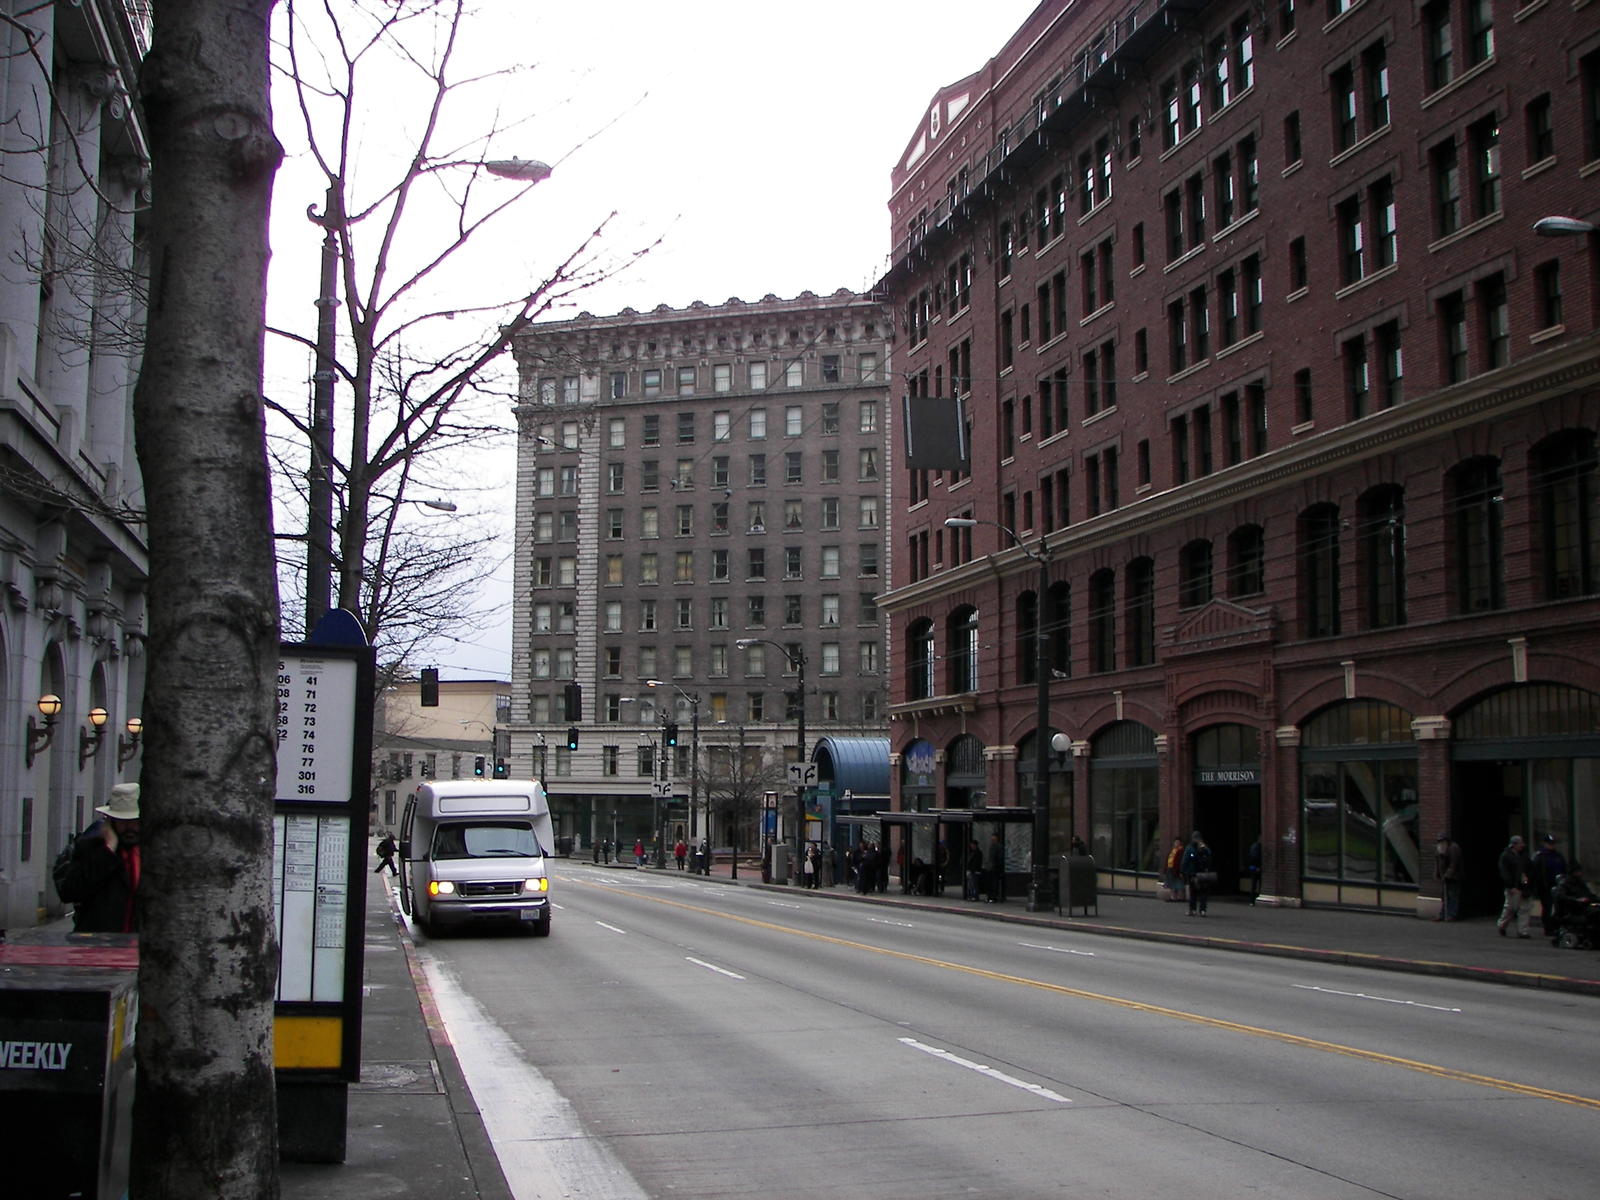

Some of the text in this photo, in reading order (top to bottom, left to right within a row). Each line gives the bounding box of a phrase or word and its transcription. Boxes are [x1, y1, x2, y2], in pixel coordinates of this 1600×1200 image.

[306, 676, 317, 686] 41
[306, 690, 316, 699] 71
[304, 703, 317, 713] 72
[303, 717, 316, 726] 73
[303, 731, 315, 740] 74
[302, 744, 315, 754] 76
[302, 758, 314, 767] 77
[298, 771, 316, 781] 301
[1217, 771, 1255, 781] MORRISON
[297, 785, 315, 794] 316
